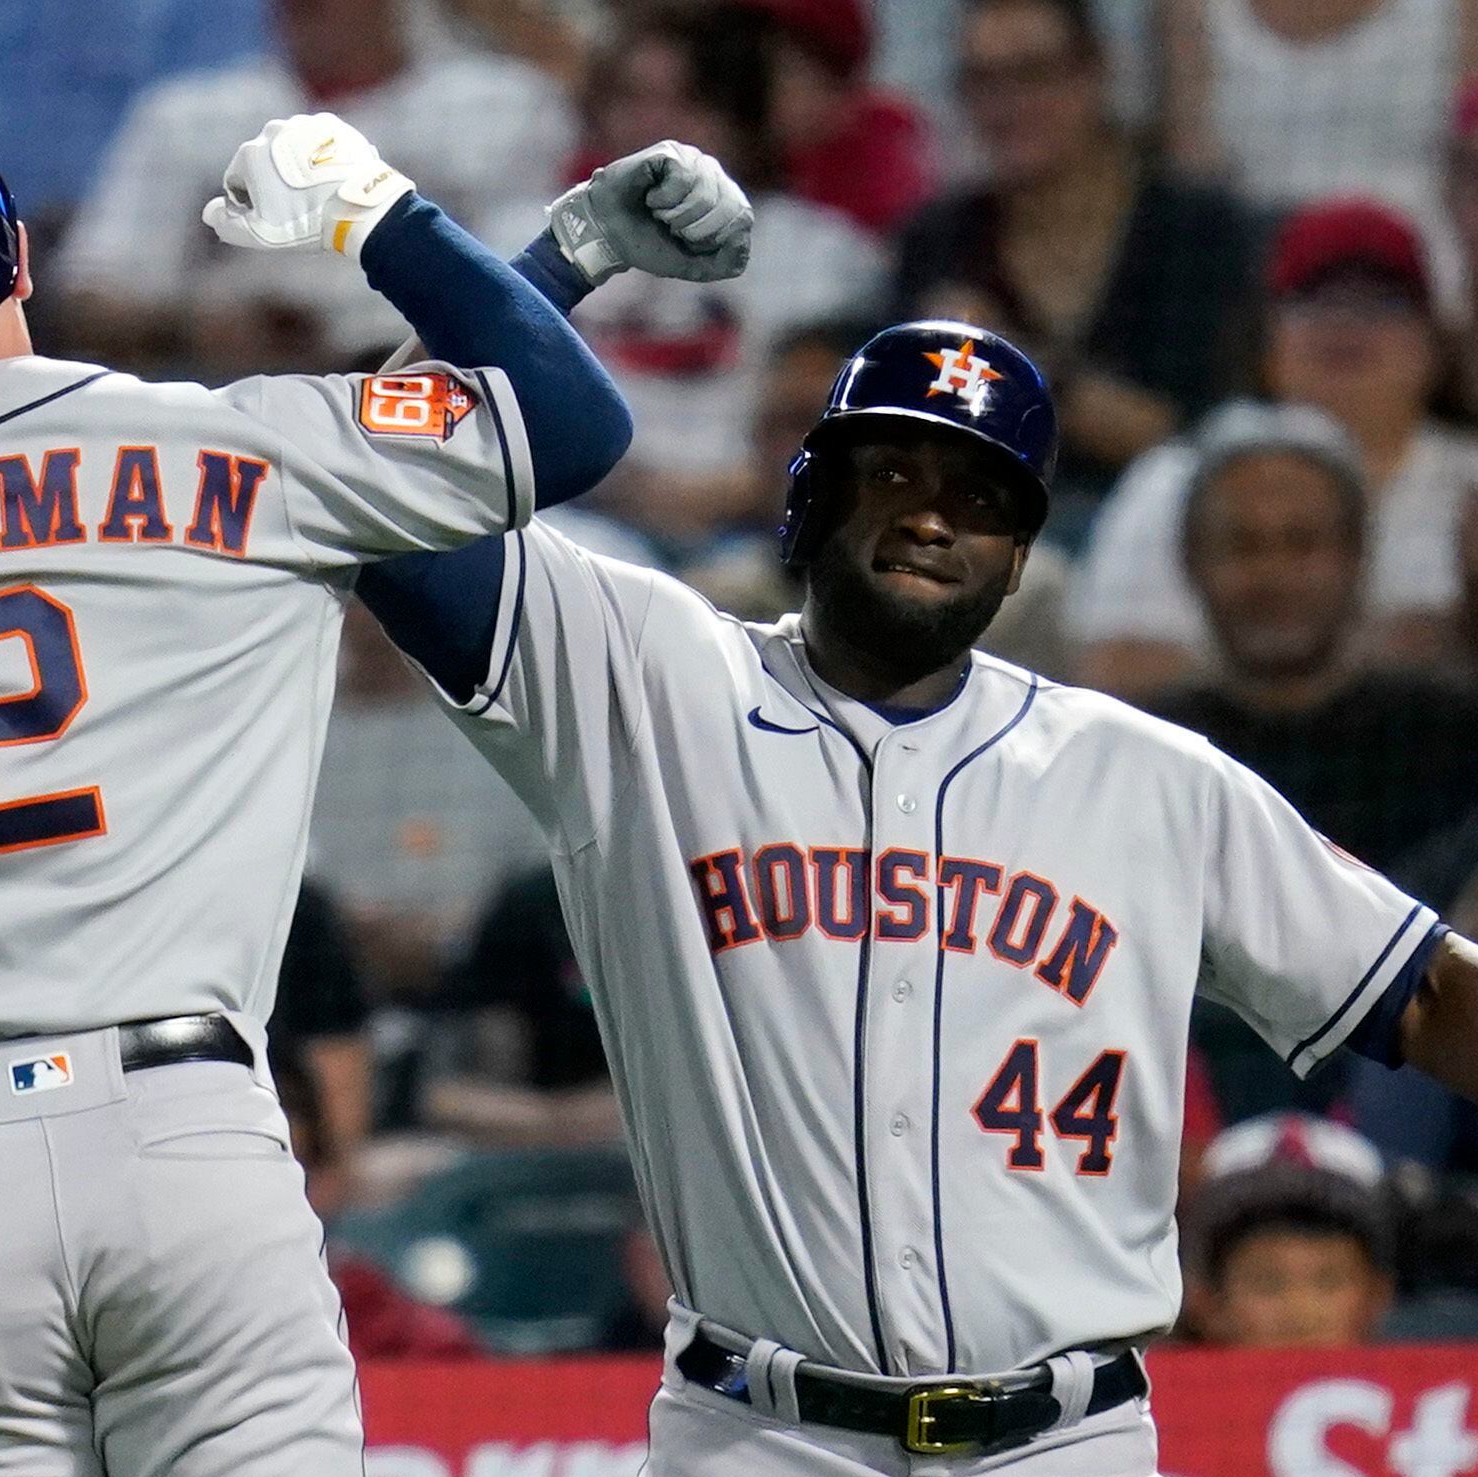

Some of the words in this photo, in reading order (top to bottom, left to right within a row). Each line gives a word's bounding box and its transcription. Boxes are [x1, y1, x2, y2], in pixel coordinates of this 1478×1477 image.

[370, 376, 434, 427] 60
[689, 841, 1120, 1008] HOUSTON
[970, 1038, 1129, 1177] 44
